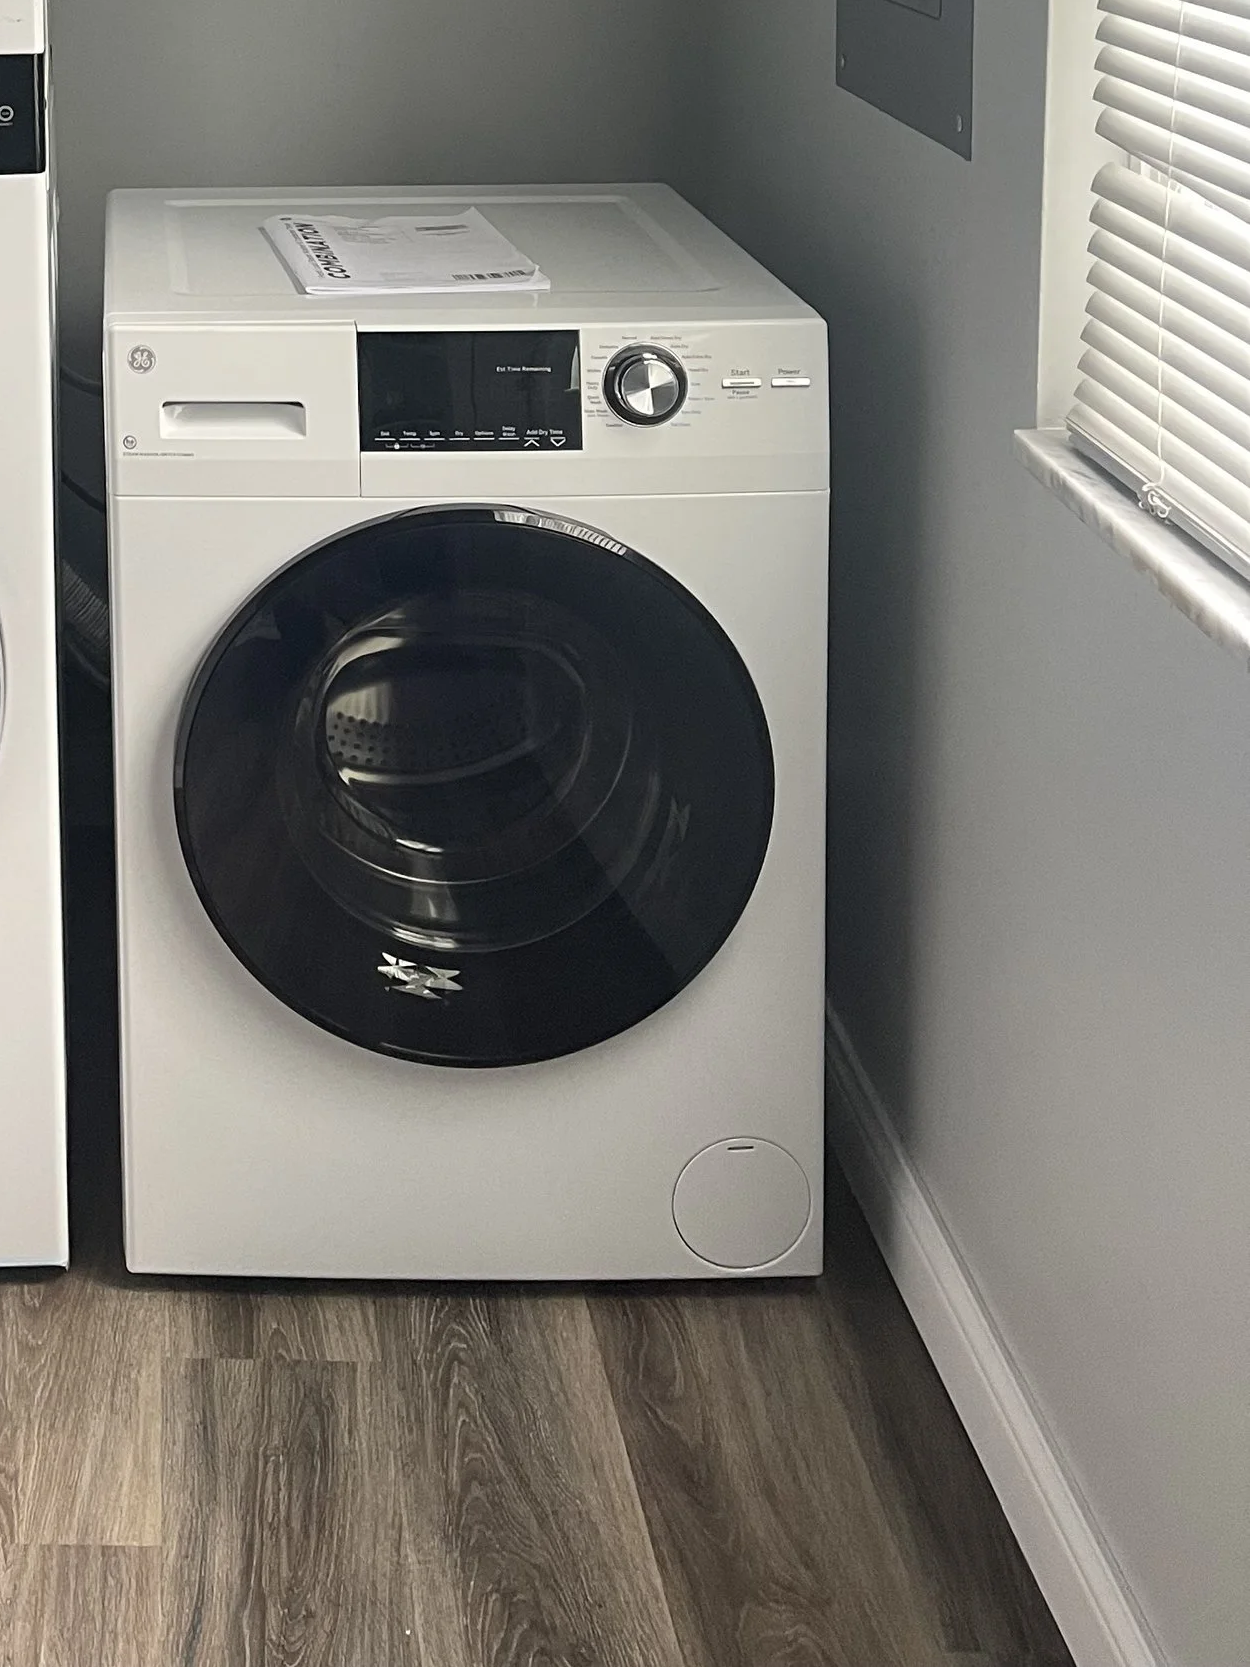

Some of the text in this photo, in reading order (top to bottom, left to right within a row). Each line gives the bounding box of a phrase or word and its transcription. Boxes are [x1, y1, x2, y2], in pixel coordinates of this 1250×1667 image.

[293, 221, 351, 280] COMBINATION
[730, 368, 750, 376] Start
[778, 367, 801, 375] Power
